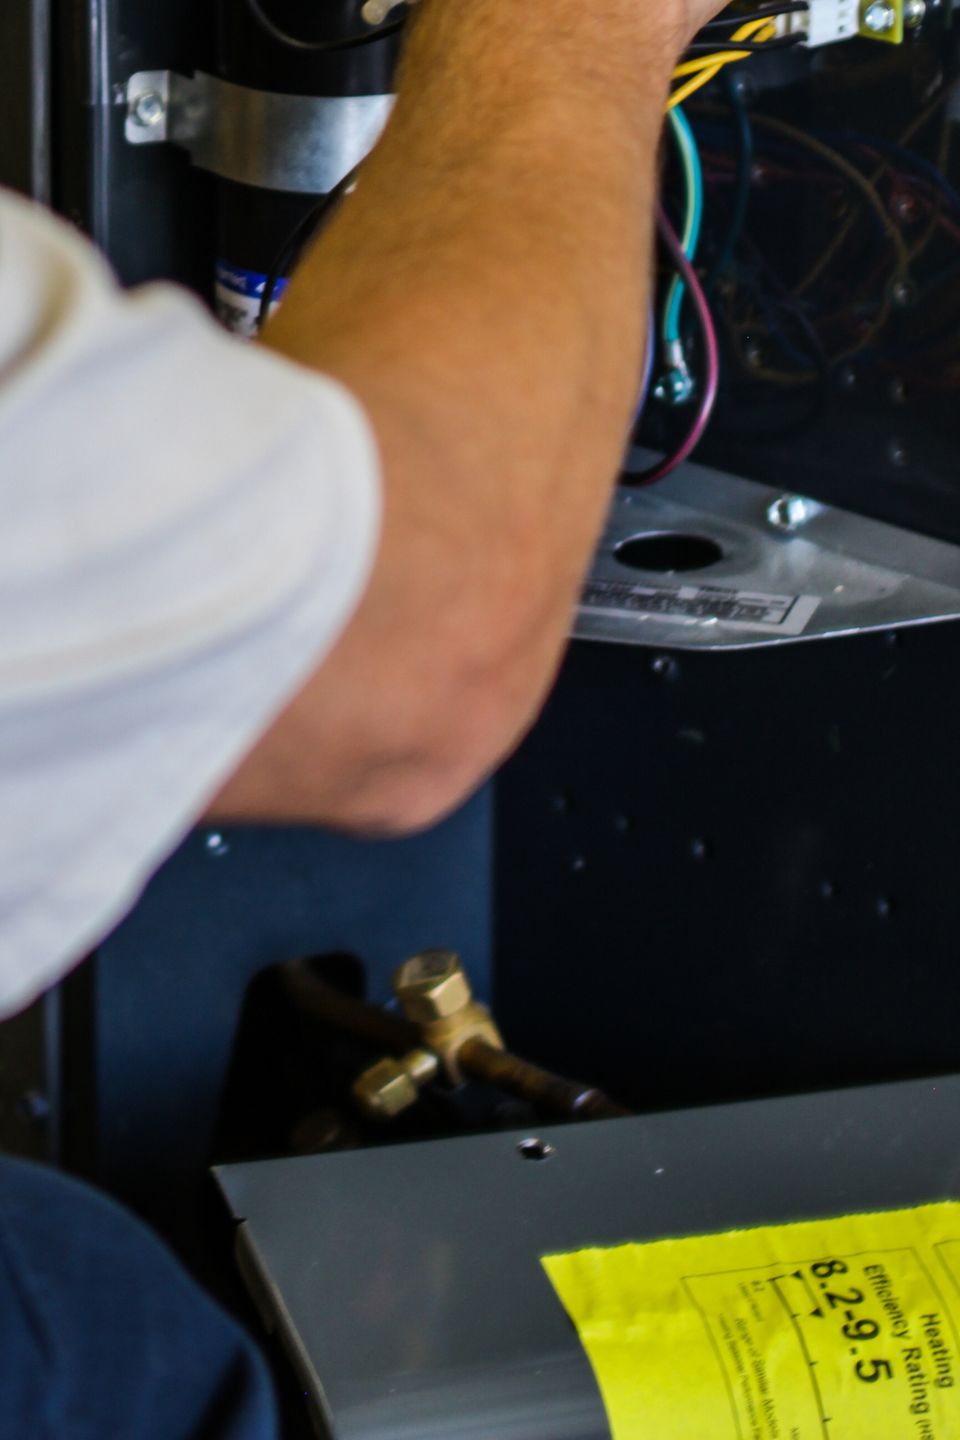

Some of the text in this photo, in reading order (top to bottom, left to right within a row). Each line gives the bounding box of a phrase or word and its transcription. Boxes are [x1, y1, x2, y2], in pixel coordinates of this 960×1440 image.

[810, 1259, 894, 1384] 8.2-9.5
[863, 1264, 911, 1340] Efficiency
[901, 1346, 931, 1415] Rating
[919, 1312, 955, 1389] Heating
